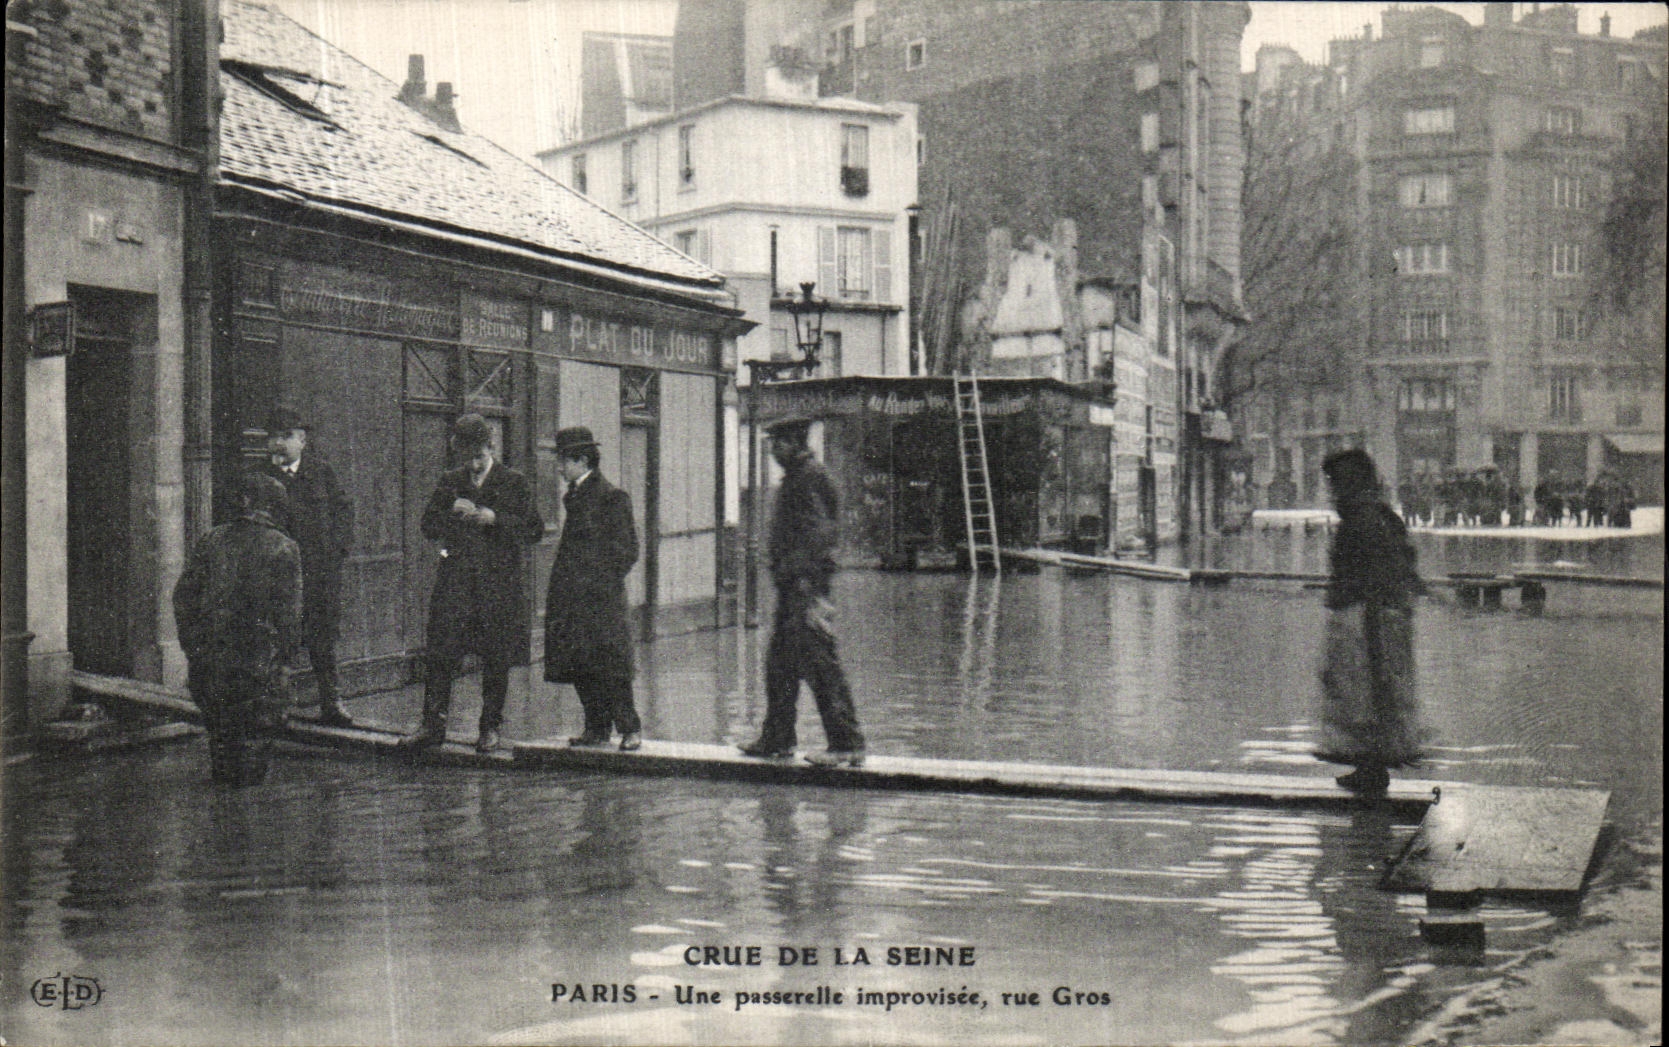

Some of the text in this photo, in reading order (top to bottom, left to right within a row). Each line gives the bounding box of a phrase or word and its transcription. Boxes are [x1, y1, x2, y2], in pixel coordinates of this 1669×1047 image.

[462, 317, 476, 334] DE
[569, 313, 709, 365] PLAT DU JOUR
